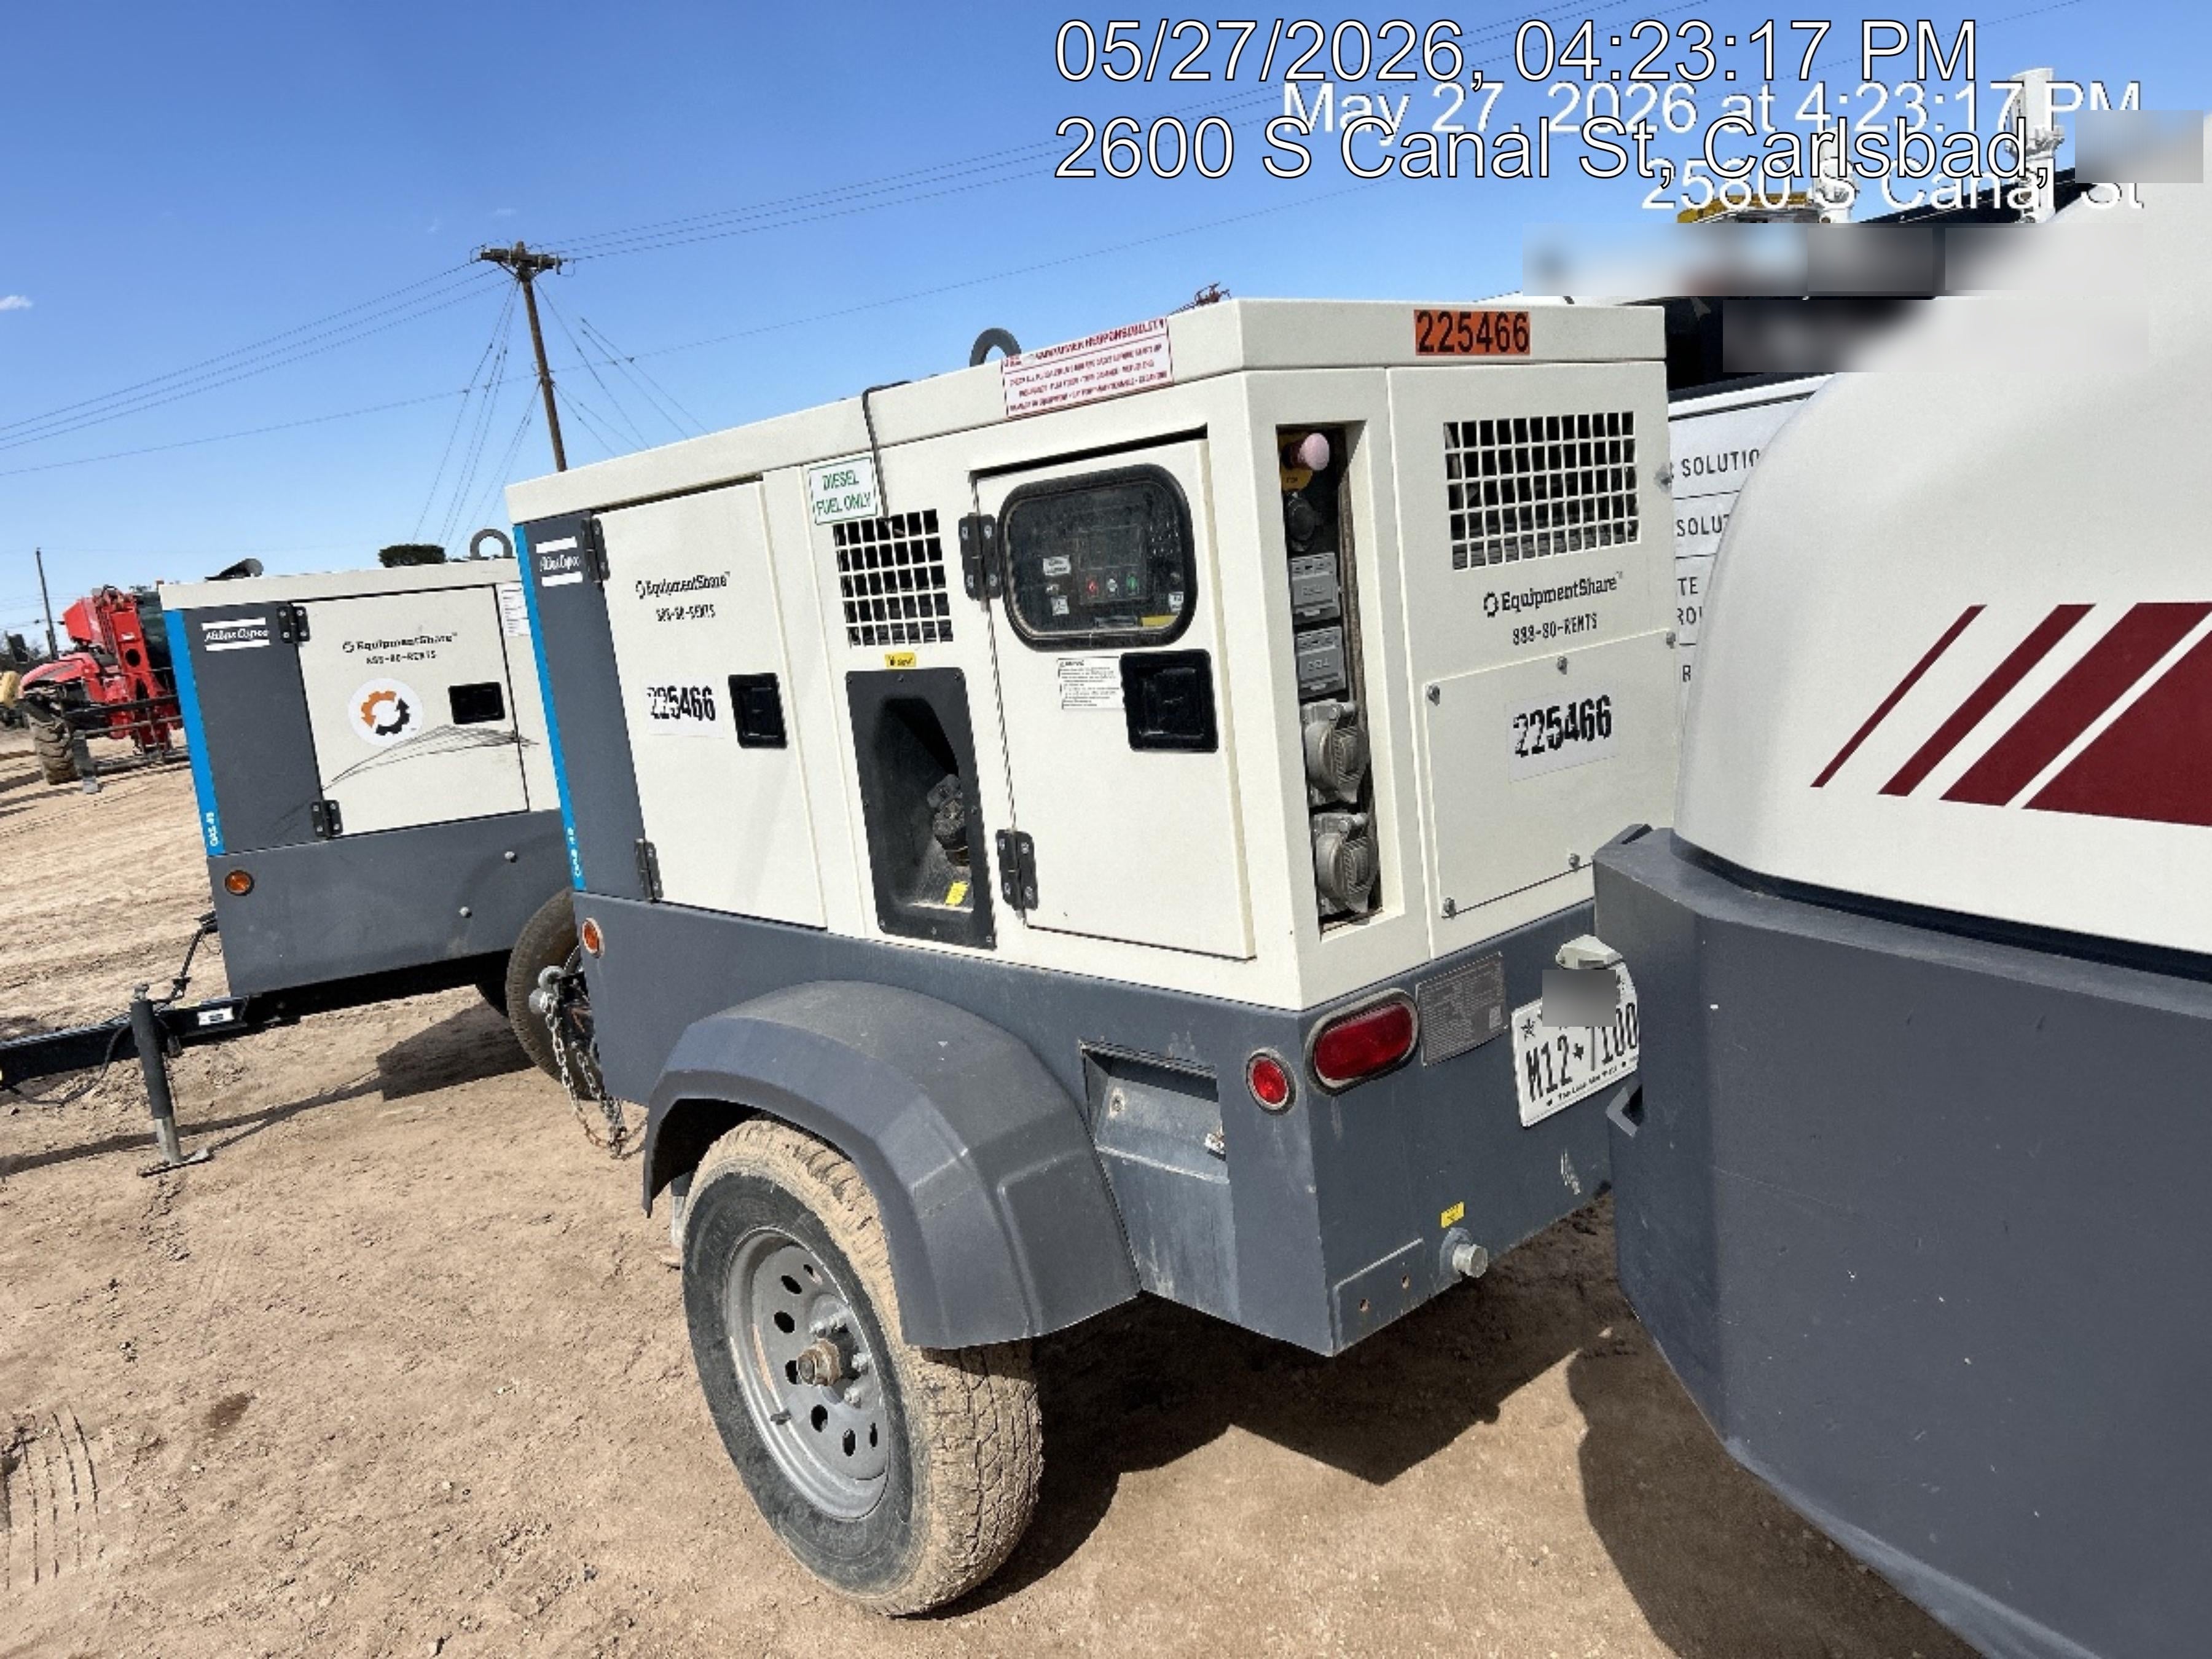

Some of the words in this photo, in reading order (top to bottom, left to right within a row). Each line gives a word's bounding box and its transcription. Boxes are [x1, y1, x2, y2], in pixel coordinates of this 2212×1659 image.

[1416, 310, 1529, 353] 225466
[822, 470, 859, 490] DIESEL
[816, 497, 842, 516] FUEL
[844, 492, 870, 511] ONLY
[1502, 576, 1617, 614] EquipmentShare
[647, 685, 716, 721] 225466
[1512, 694, 1612, 758] 225466
